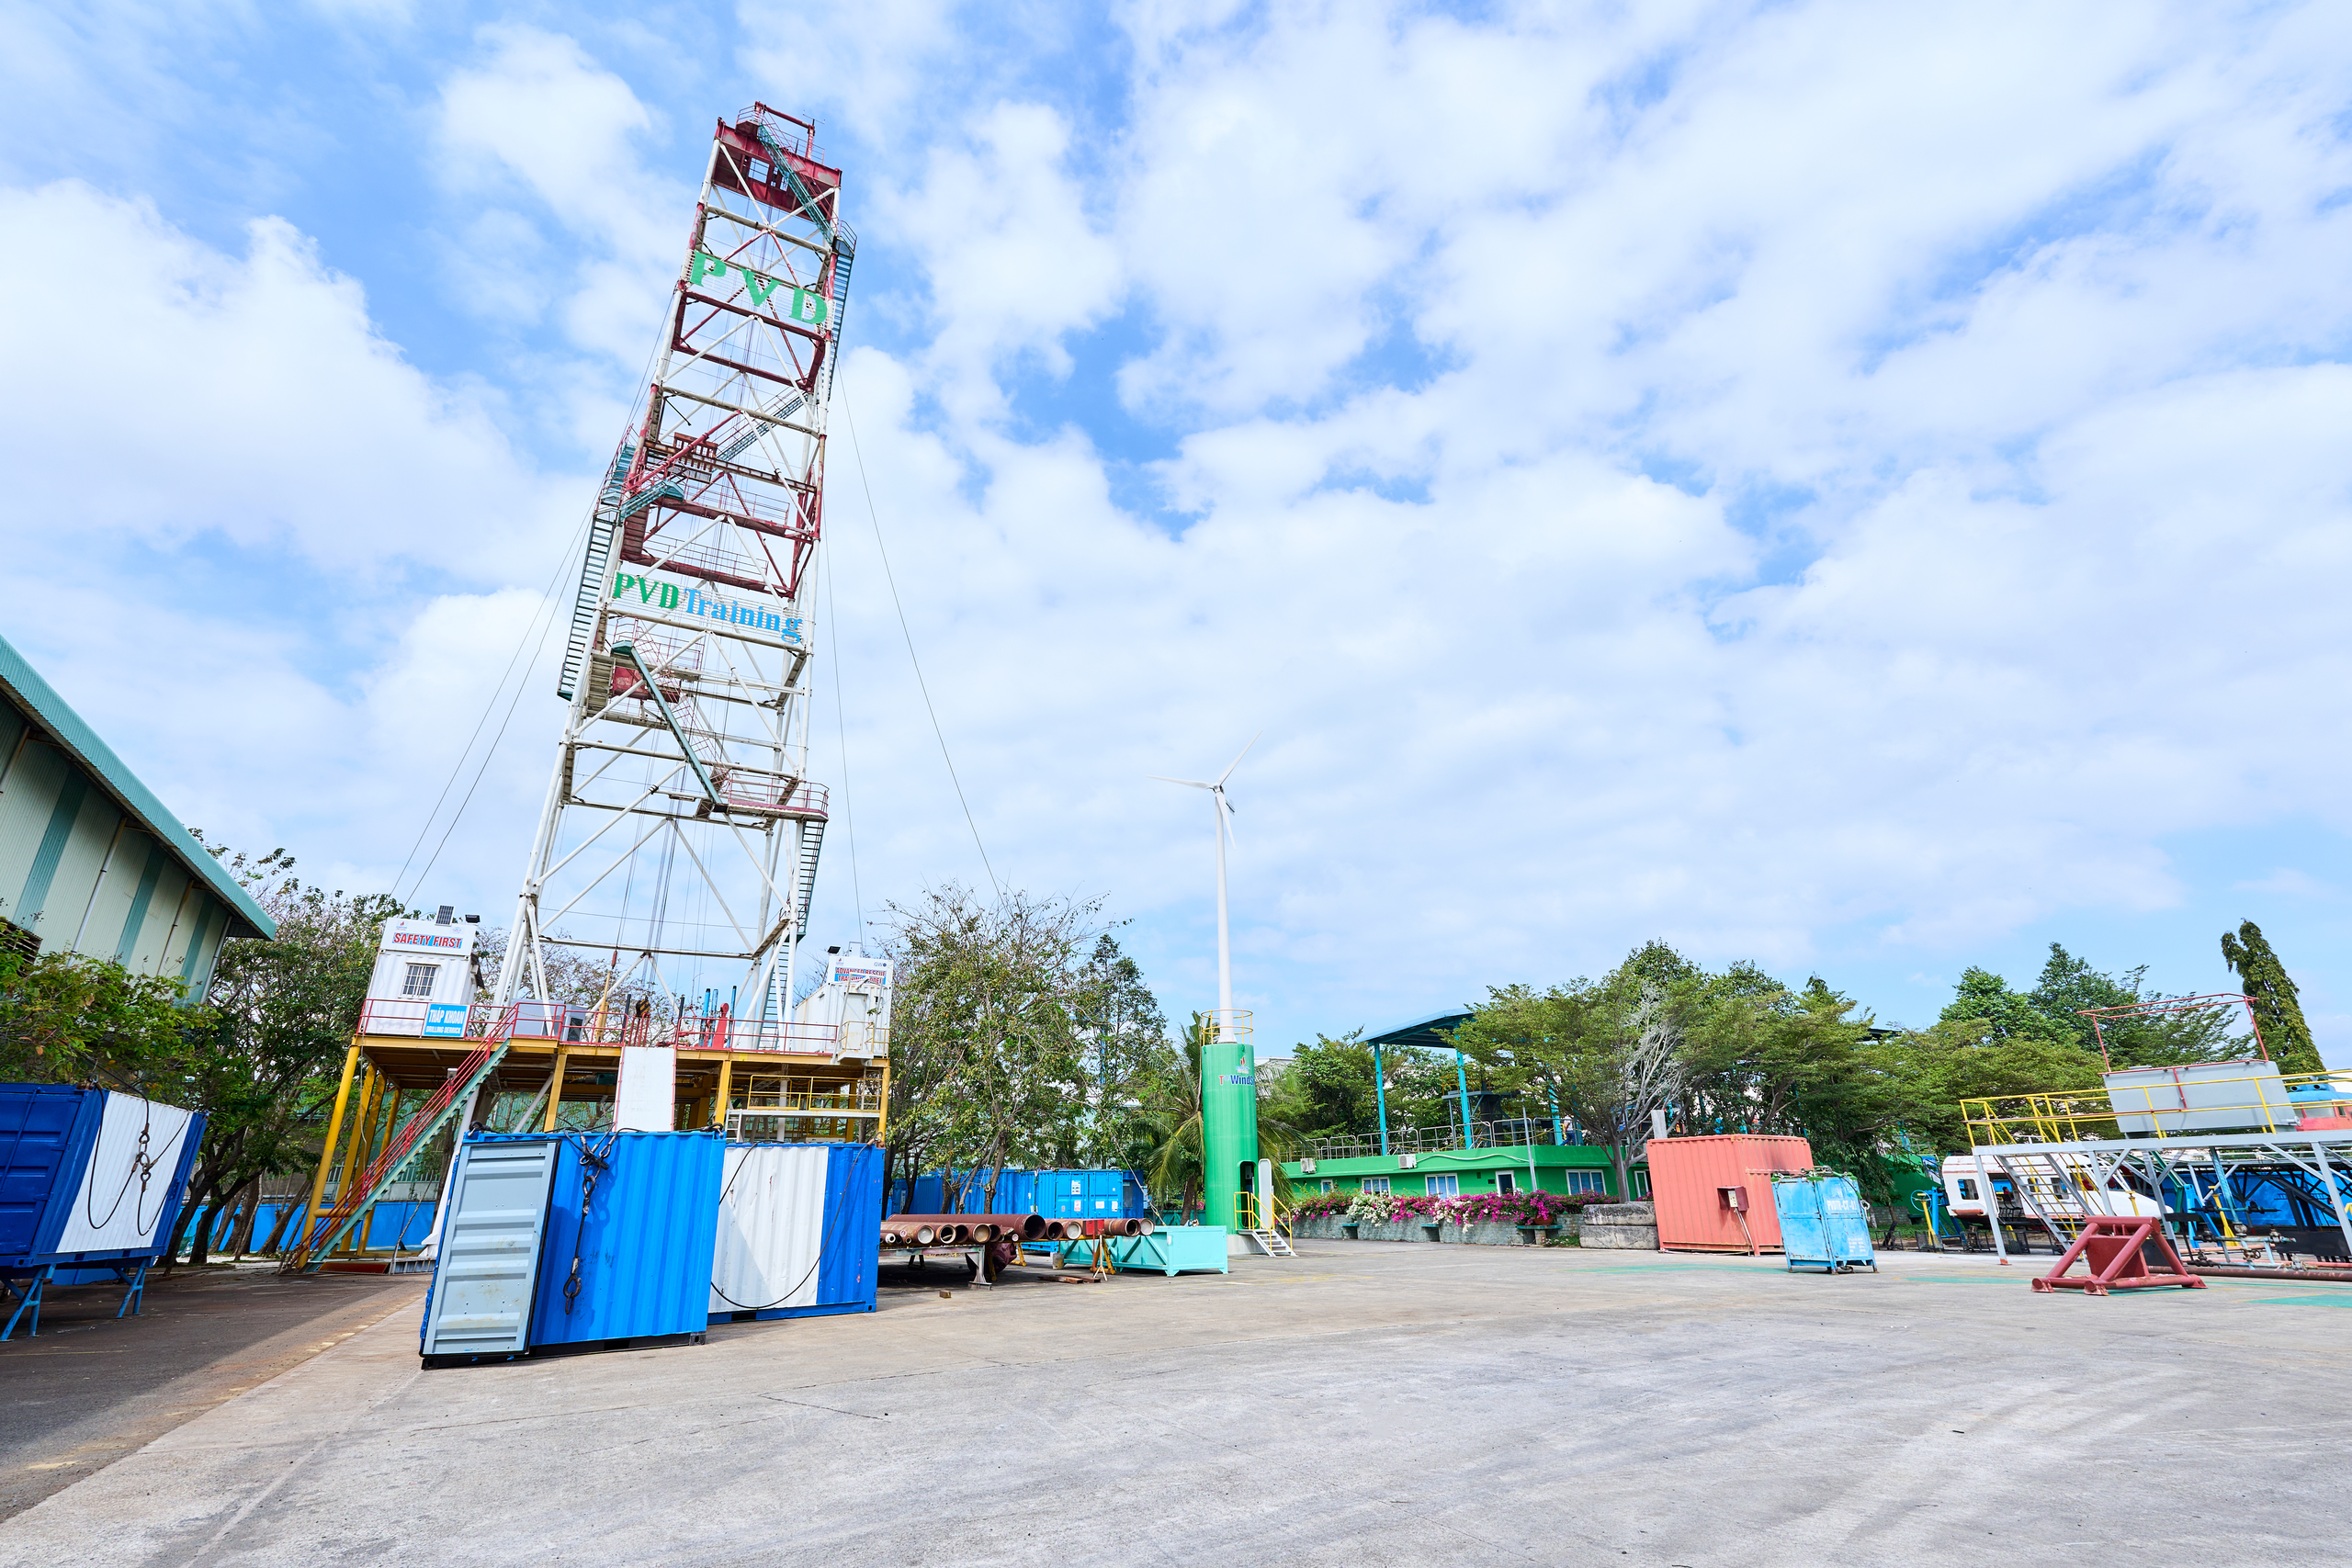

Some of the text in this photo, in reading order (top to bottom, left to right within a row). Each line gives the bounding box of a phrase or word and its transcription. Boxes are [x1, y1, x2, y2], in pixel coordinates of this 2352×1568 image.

[690, 251, 828, 324] PVD
[613, 571, 802, 644] PVD Training
[393, 932, 462, 948] SAFETY FIRST
[428, 1007, 466, 1024] THÁP KHOAN
